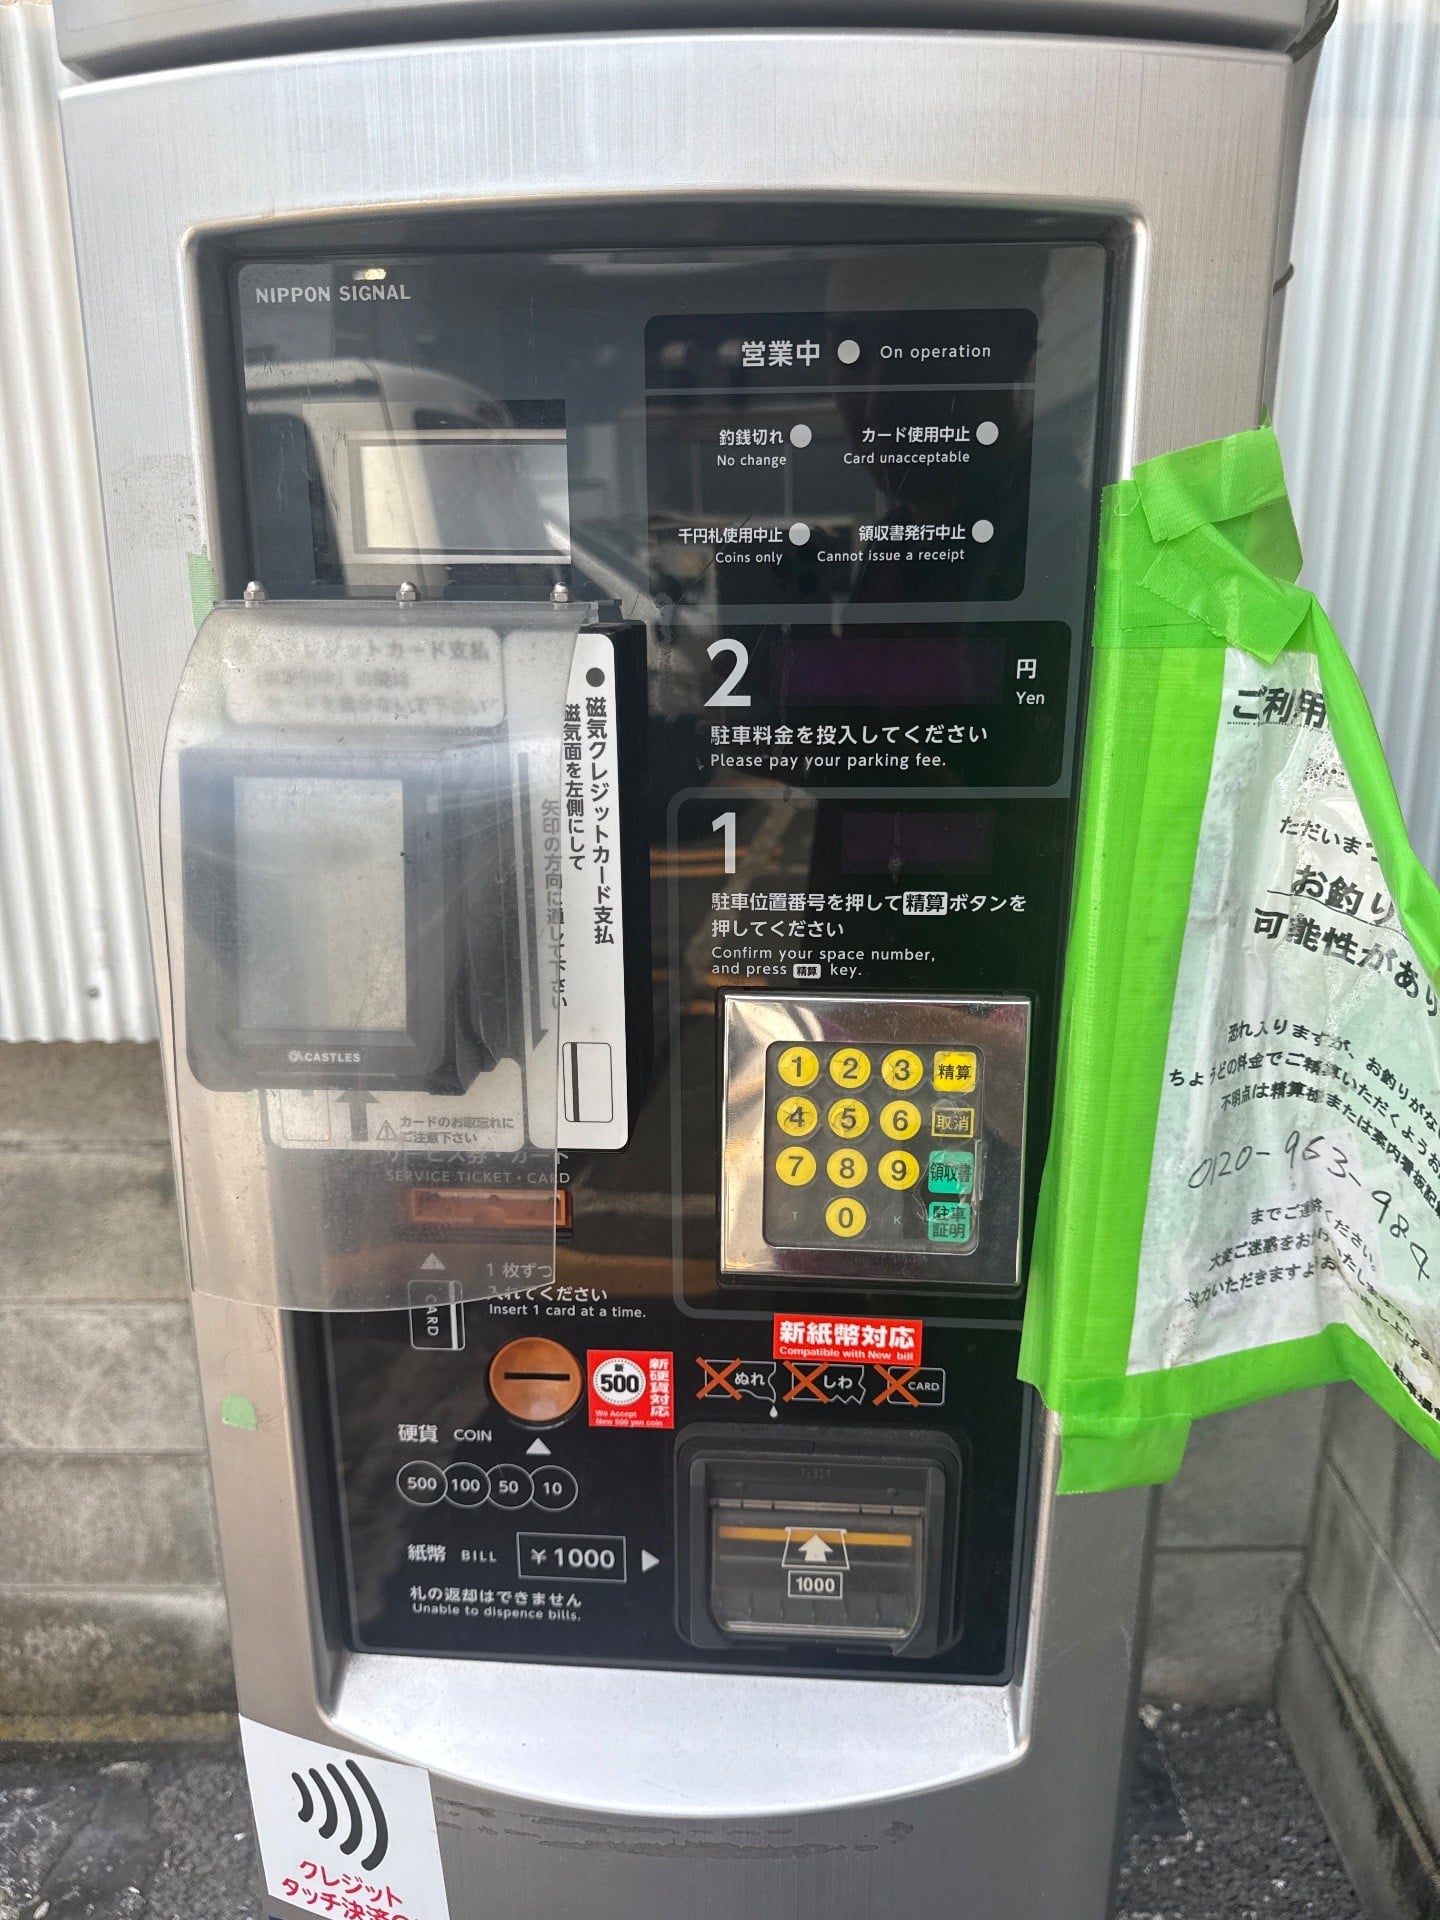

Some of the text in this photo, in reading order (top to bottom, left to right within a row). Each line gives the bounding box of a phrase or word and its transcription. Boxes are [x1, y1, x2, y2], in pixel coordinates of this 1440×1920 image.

[255, 284, 411, 304] NIPPON SIGNAL
[741, 340, 820, 367] 営業中
[880, 344, 991, 362] On operation
[719, 429, 784, 447] 釣銭切れ
[861, 426, 970, 443] カード使用中止
[717, 454, 787, 468] No change
[843, 450, 970, 466] Card unacceptable
[678, 527, 783, 545] 千円札使用中止
[859, 524, 966, 541] 領収書発行中止
[715, 551, 783, 566] Coins only
[817, 549, 965, 564] Cannot issue a receipt
[703, 638, 751, 707] 2
[1016, 658, 1037, 679] 円
[1016, 691, 1045, 705] Yen
[710, 724, 988, 747] 駐車料金を投入してください
[710, 753, 947, 771] Please pay your parking fee.
[585, 696, 615, 945] 磁気クレジットカード支払
[711, 812, 736, 874] 1
[711, 919, 844, 938] 押してください
[711, 946, 936, 963] Confirm your space number,
[711, 962, 862, 978] and press 精算 key.
[303, 1051, 361, 1063] CASTLES
[791, 1055, 802, 1078] 1
[842, 1057, 858, 1080] 2
[894, 1059, 910, 1081] 3
[937, 1064, 972, 1081] 精算
[790, 1106, 805, 1128] 4
[841, 1108, 857, 1130] 5
[892, 1109, 909, 1132] 6
[936, 1114, 969, 1131] 取消
[788, 1155, 804, 1177] 7
[839, 1157, 855, 1179] 8
[891, 1159, 907, 1182] 9
[929, 1162, 972, 1182] 領収書
[386, 1170, 451, 1183] SERVICE
[838, 1206, 854, 1229] 0
[933, 1205, 966, 1222] 駐車
[933, 1222, 966, 1239] 証明
[425, 1294, 439, 1336] CARD
[489, 1303, 647, 1318] Insert 1 card at a time.
[779, 1320, 916, 1350] 新紙幣対応
[779, 1346, 914, 1361] Compatible with New bill
[600, 1374, 640, 1393] 500
[734, 1370, 766, 1388] ぬれ
[823, 1375, 853, 1390] しわ
[908, 1381, 940, 1392] CARD
[398, 1423, 492, 1442] 硬貨 COIN
[407, 1476, 438, 1491] 500
[451, 1478, 481, 1492] 100
[498, 1479, 519, 1494] 50
[542, 1481, 562, 1496] 10
[407, 1543, 447, 1563] 紙幣
[461, 1549, 497, 1563] BILL
[795, 1577, 836, 1593] 1000
[409, 1585, 582, 1608] 札の返却はできません
[411, 1602, 582, 1622] Unable to dispence bills.
[300, 1861, 403, 1907] クレジット
